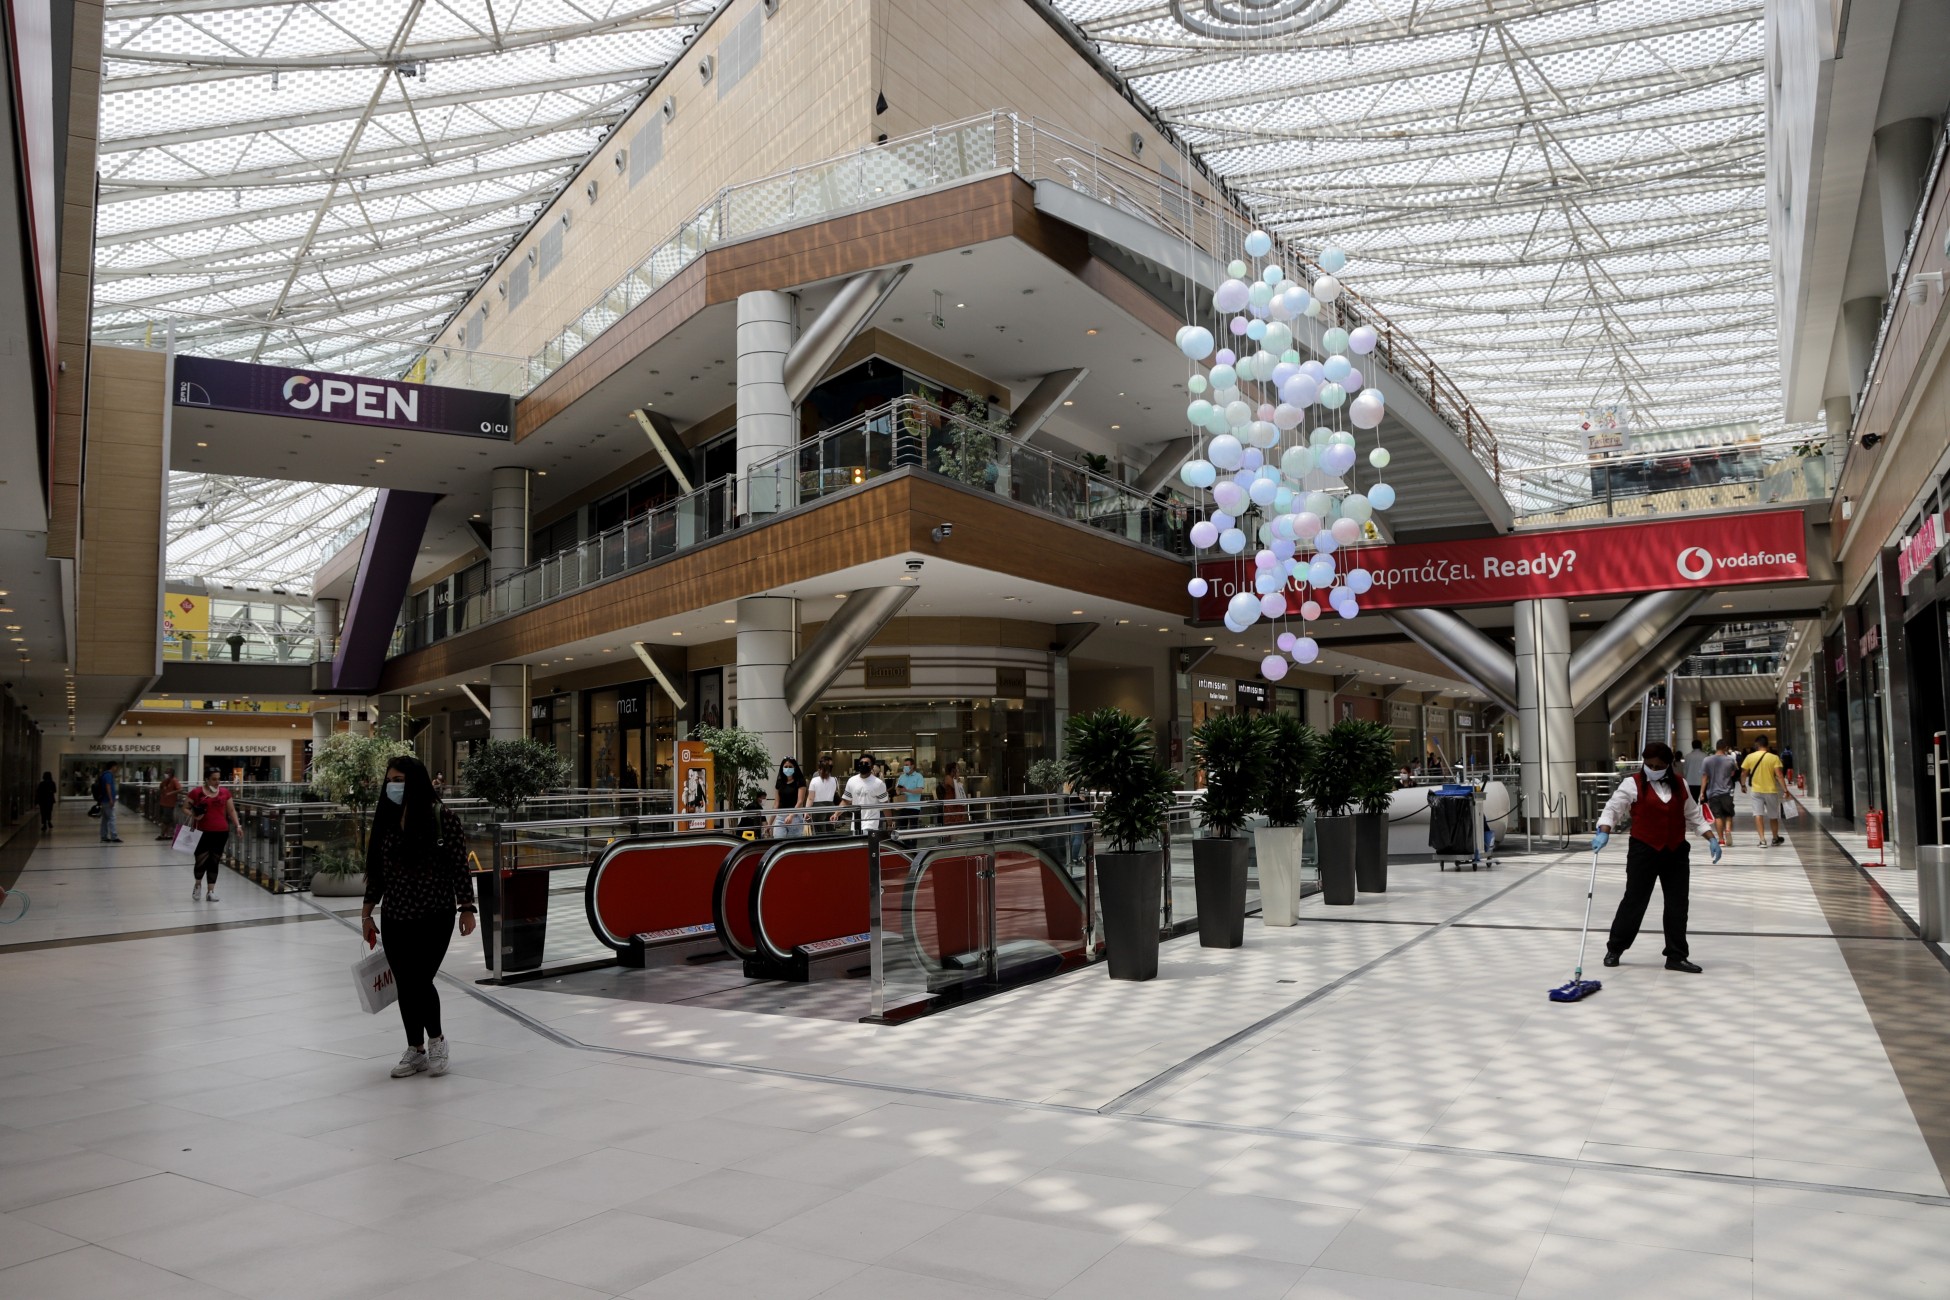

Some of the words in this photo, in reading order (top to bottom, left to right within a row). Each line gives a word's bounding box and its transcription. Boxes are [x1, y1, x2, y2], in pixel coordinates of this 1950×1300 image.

[283, 375, 418, 422] OPEN
[495, 424, 508, 434] CU
[1483, 550, 1577, 579] Ready?
[1716, 551, 1797, 569] vodafone
[1742, 719, 1772, 727] ZARA
[89, 744, 117, 752] MARKS
[118, 744, 123, 752] &
[124, 744, 161, 752] SPENCER
[214, 745, 238, 753] MARKS
[239, 745, 245, 753] &
[245, 745, 277, 753] SPENCER
